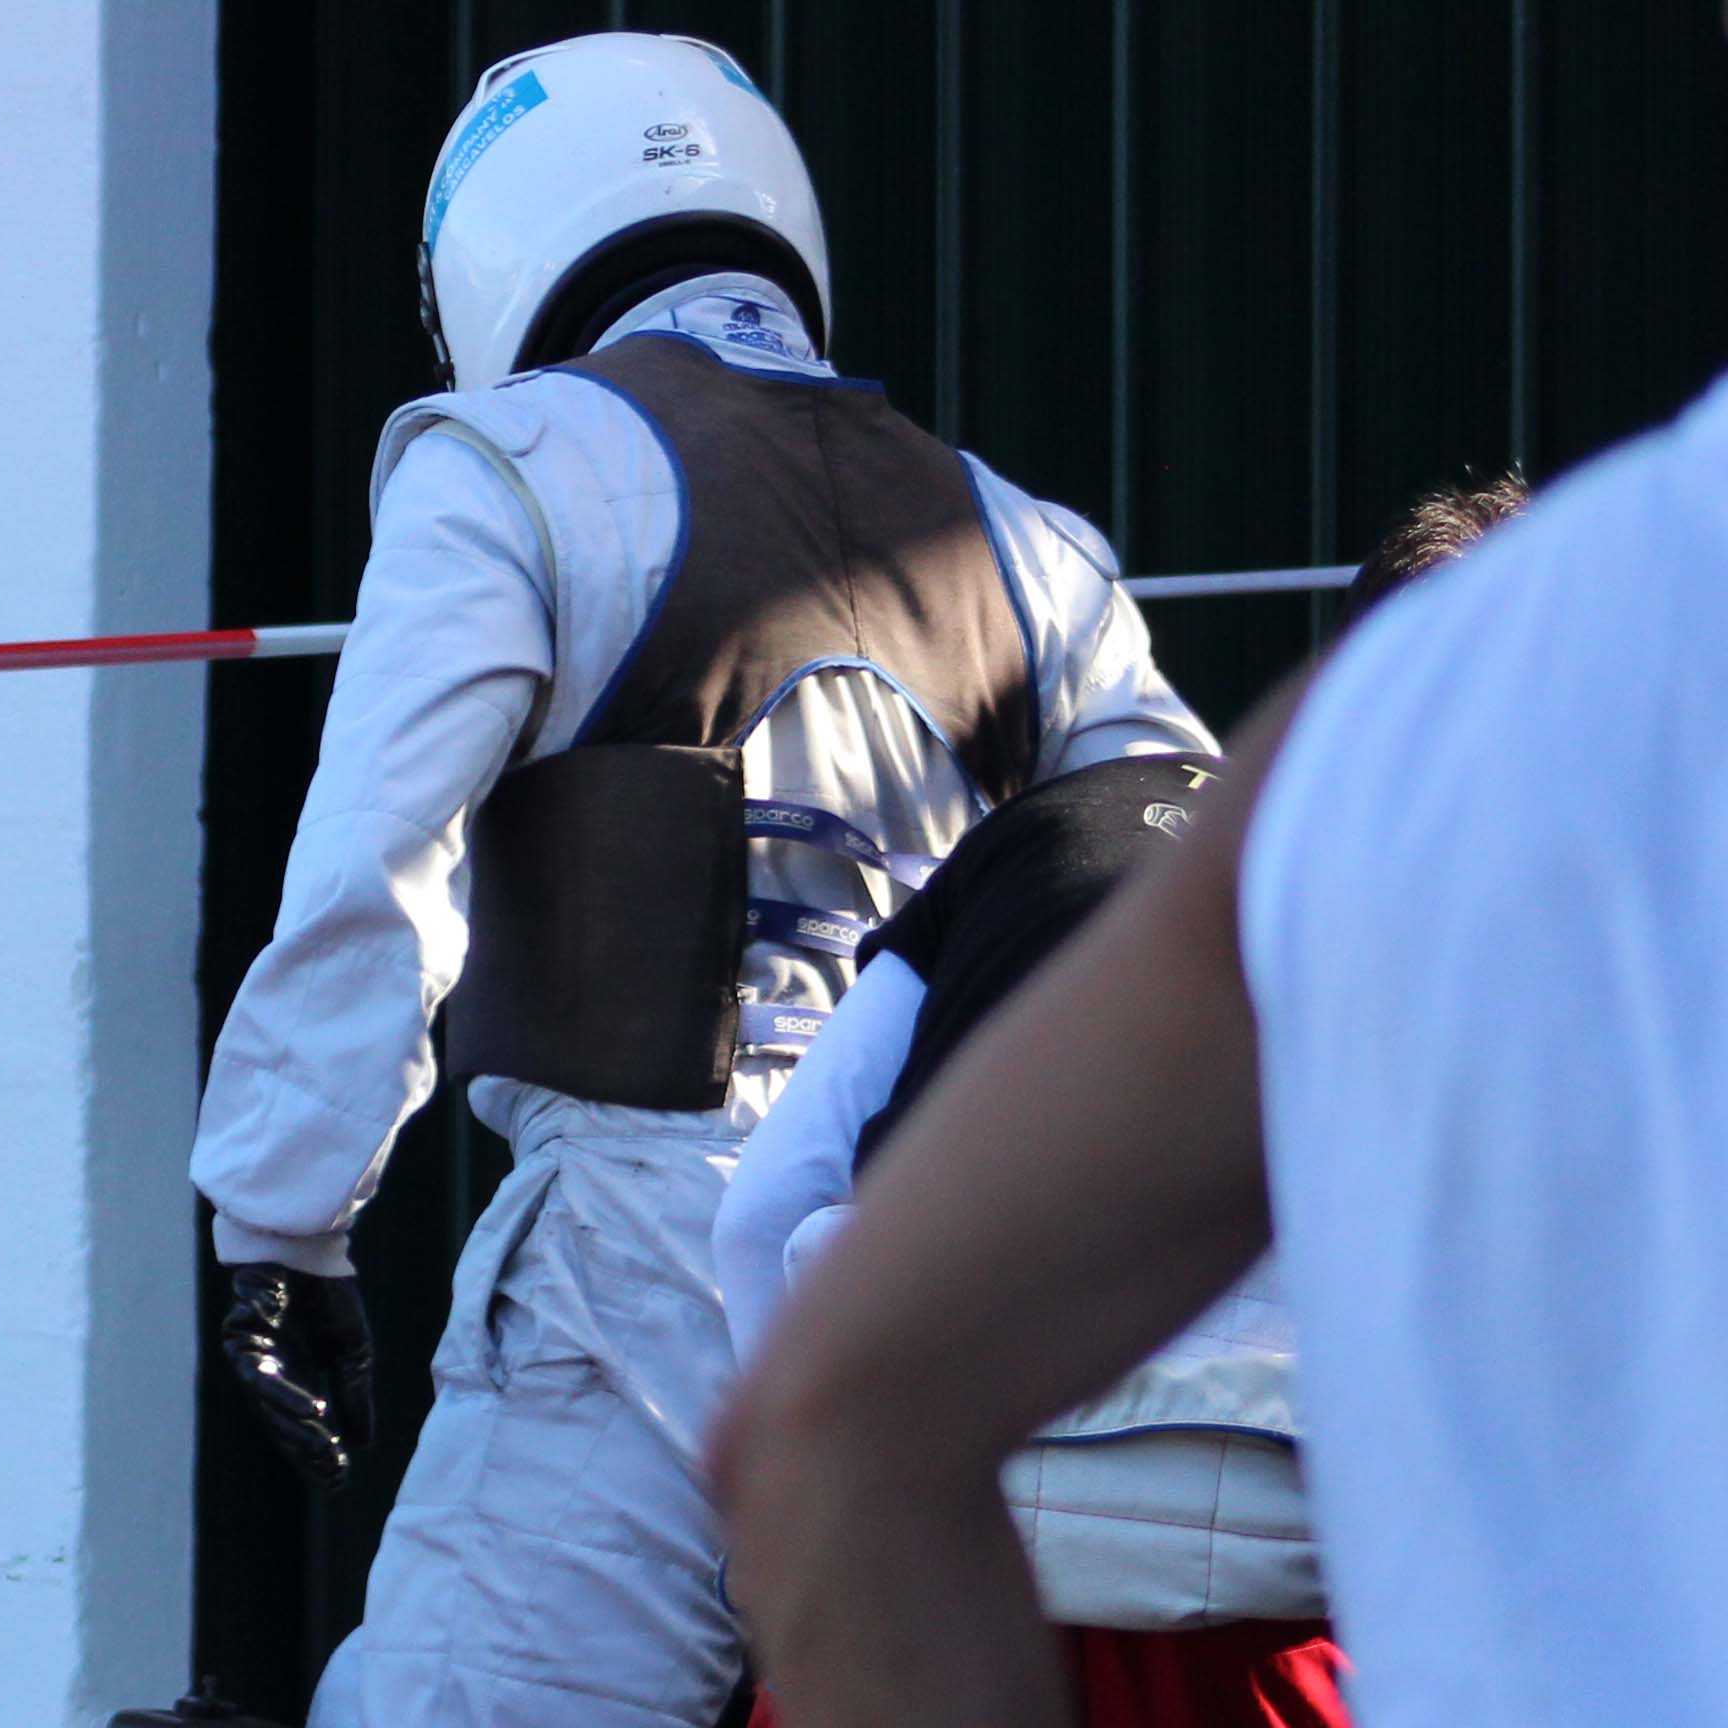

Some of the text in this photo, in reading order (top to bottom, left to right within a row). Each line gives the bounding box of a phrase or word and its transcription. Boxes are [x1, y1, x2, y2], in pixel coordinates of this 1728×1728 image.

[642, 143, 701, 162] SK-6
[797, 916, 859, 946] sparco
[774, 1015, 823, 1036] spar
